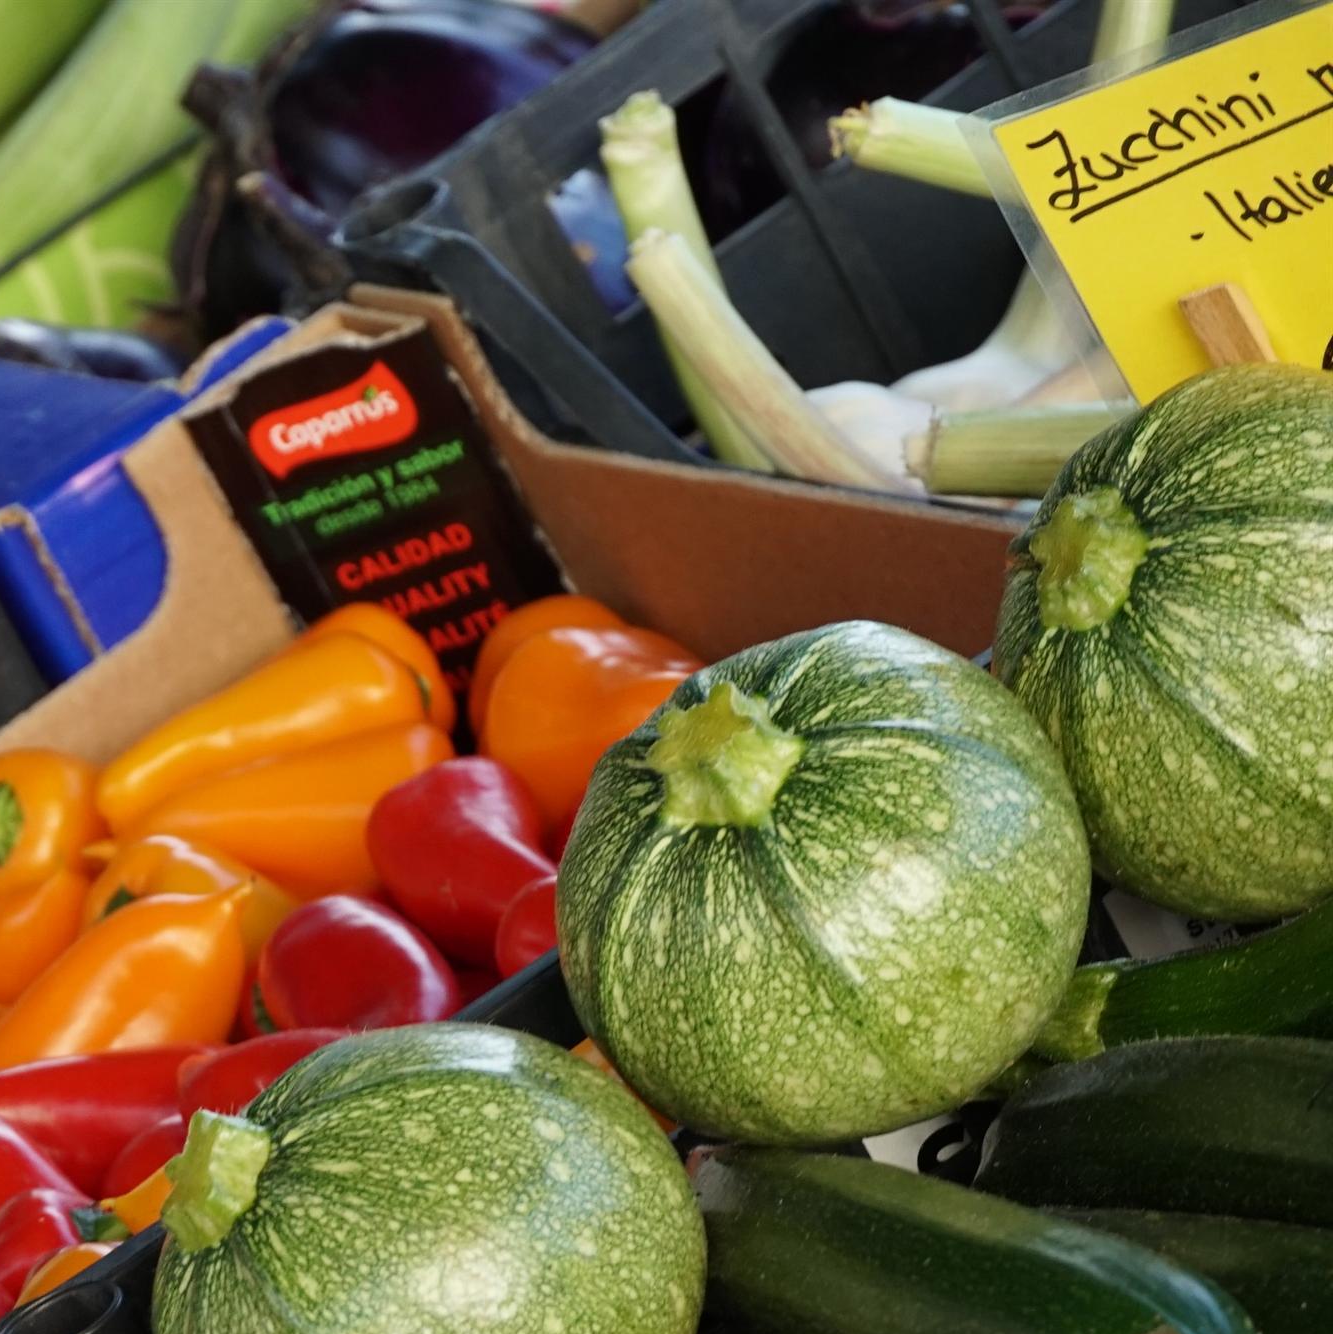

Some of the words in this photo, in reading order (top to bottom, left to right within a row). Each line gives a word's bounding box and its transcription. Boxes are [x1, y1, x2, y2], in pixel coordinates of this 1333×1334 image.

[1025, 71, 1276, 210] Zucchini
[336, 522, 472, 590] CALIDAD
[382, 562, 490, 619] UALITY
